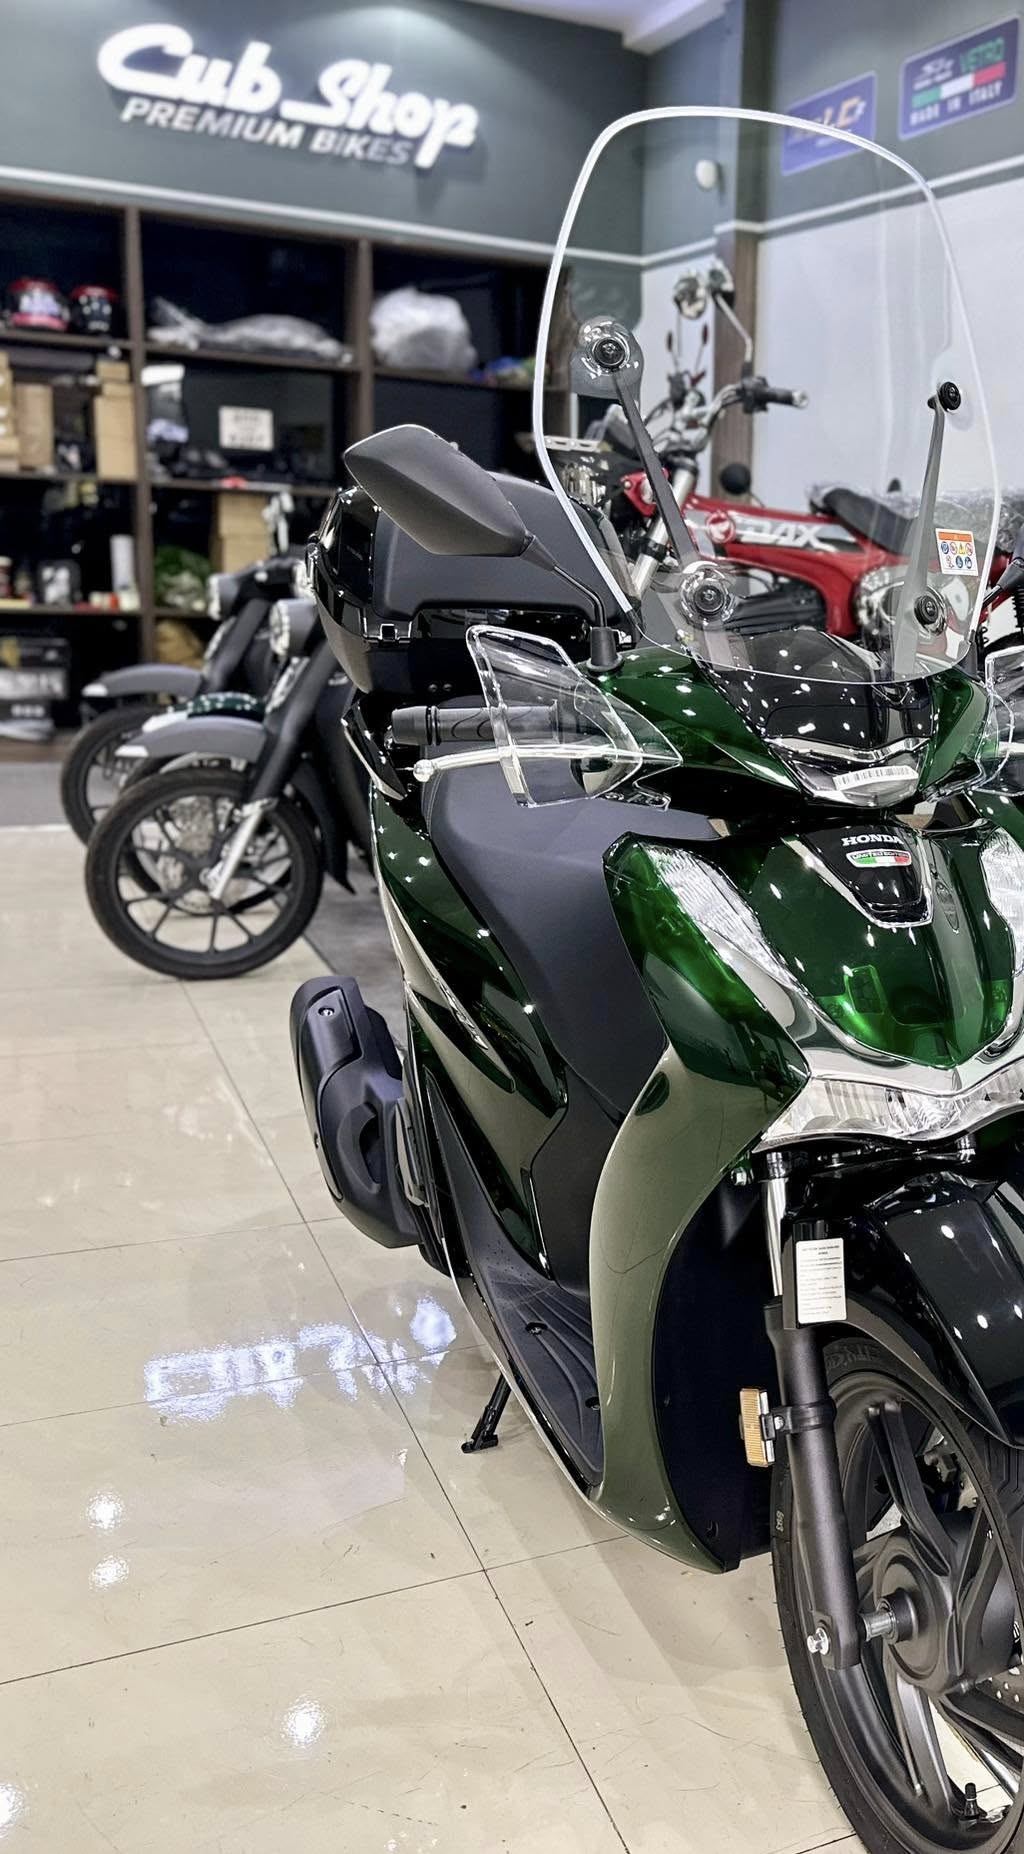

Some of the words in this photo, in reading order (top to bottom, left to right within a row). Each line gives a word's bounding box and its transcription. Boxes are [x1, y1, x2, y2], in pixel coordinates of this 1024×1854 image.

[97, 23, 282, 113] Cub
[279, 59, 480, 169] Shop
[909, 104, 940, 126] MADE
[946, 96, 962, 113] IN
[968, 80, 1003, 105] ITALY
[121, 98, 301, 150] PREMIUM
[309, 130, 413, 166] BIKES
[733, 516, 839, 553] DAX
[841, 834, 904, 846] HONDA
